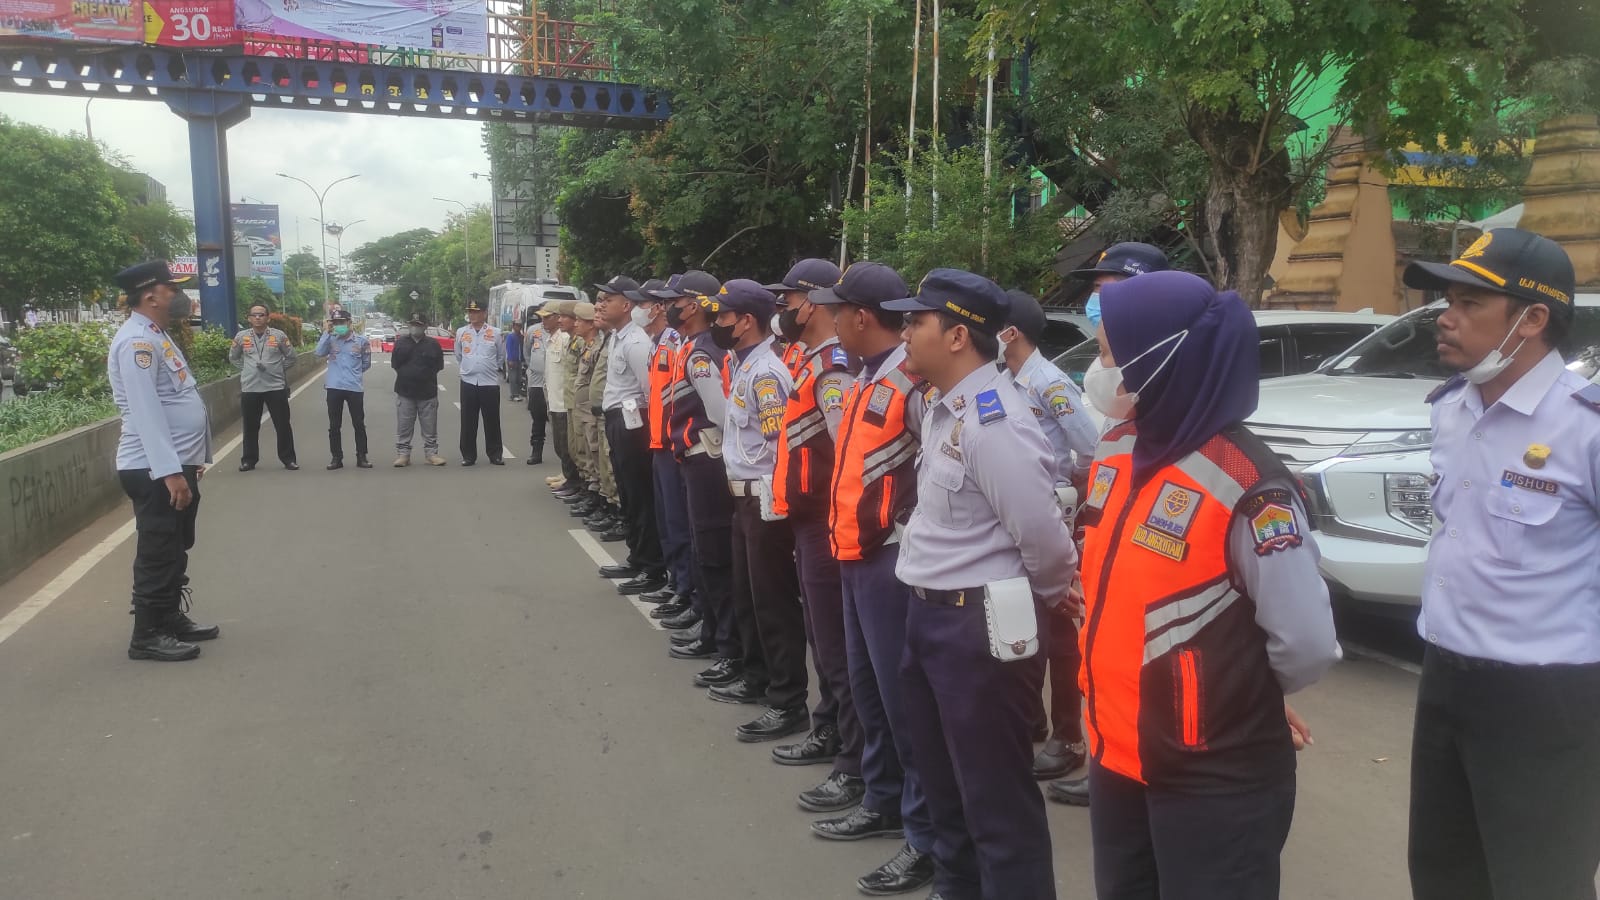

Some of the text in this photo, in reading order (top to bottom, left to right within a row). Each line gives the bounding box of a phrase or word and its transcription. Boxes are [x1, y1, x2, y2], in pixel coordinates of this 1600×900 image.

[72, 2, 134, 20] CREATIVE
[170, 6, 209, 14] ANGSURAN
[170, 13, 211, 41] 30
[1519, 277, 1536, 289] UJI
[1505, 472, 1555, 492] DISHUB
